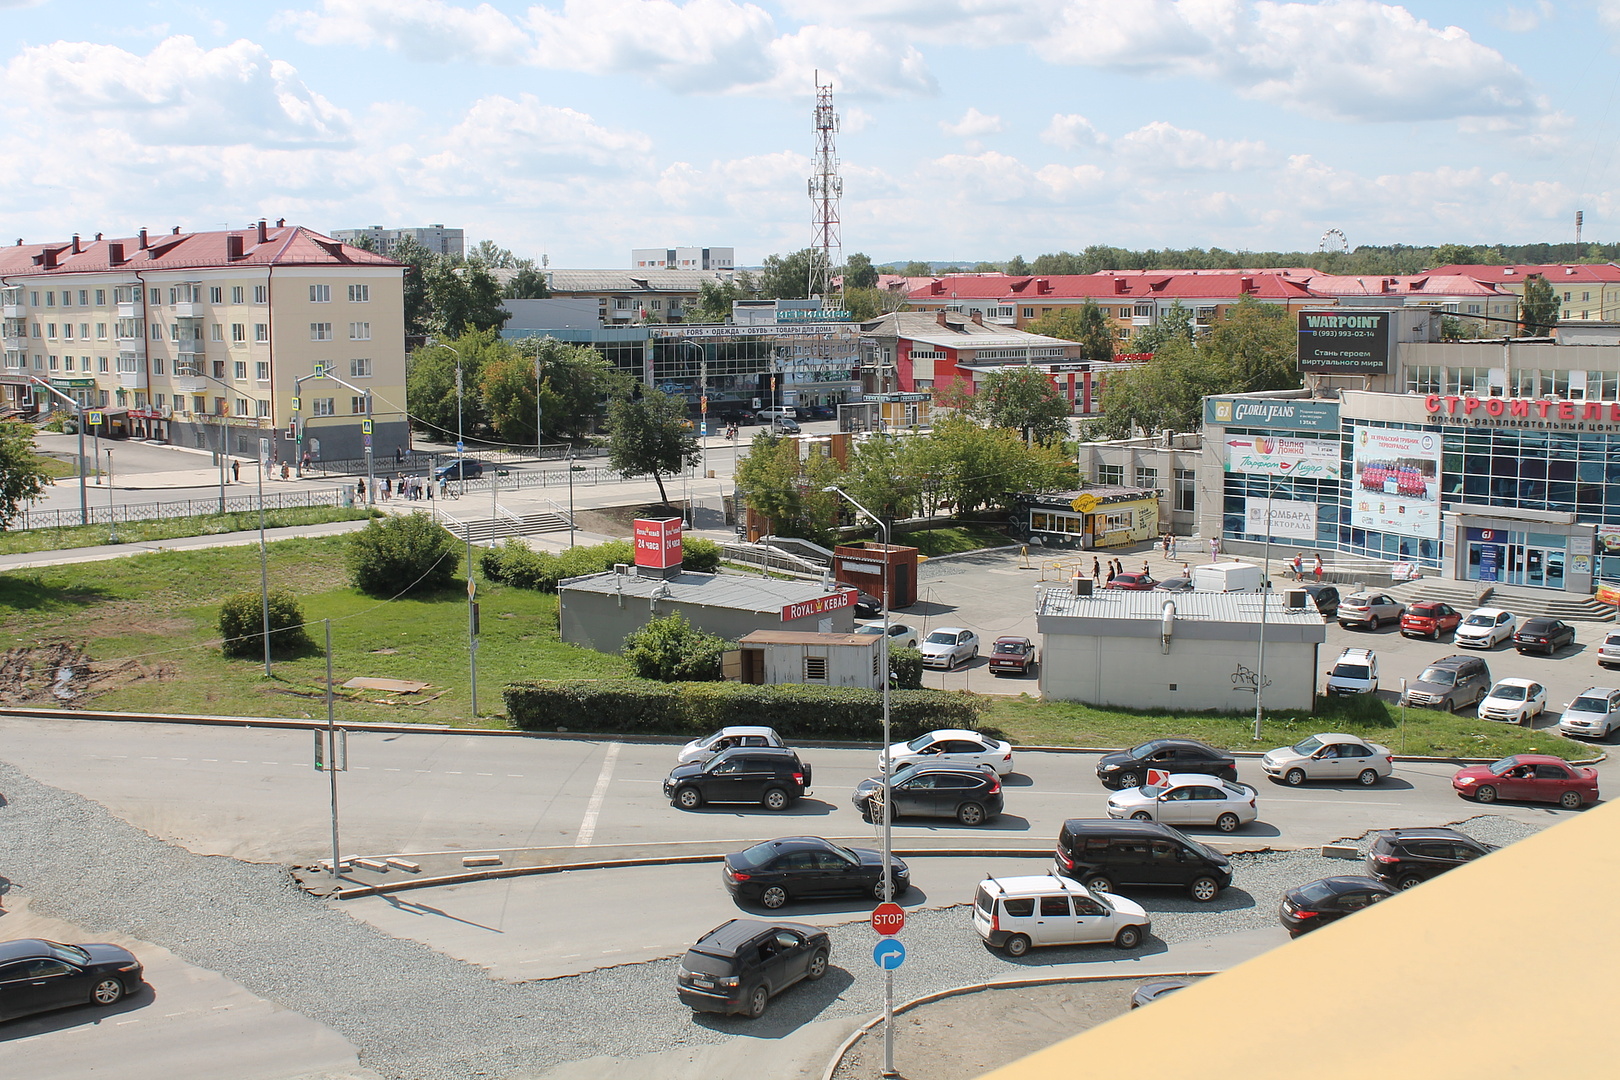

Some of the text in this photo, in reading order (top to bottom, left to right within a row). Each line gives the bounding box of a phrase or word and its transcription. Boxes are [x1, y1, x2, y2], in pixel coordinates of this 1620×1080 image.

[712, 328, 740, 336] ОДЕЖДА
[747, 327, 768, 335] ОБУВЬ
[776, 326, 800, 334] ТОВАРЫ
[802, 326, 815, 334] ДЛЯ
[1319, 330, 1337, 338] (993)
[1314, 349, 1371, 358] Стань героем
[1302, 359, 1384, 368] виртуального мира
[1236, 404, 1267, 420] GLORIA
[1265, 405, 1295, 422] JEANS
[1426, 415, 1584, 431] торгово-развлекательный
[1279, 439, 1304, 448] Вилка
[1263, 509, 1311, 522] ЛОМБАРД
[1481, 531, 1492, 539] GJ
[637, 539, 660, 550] 24 часа
[791, 593, 848, 619] ROYAL KEBAB
[874, 913, 903, 925] STOP
